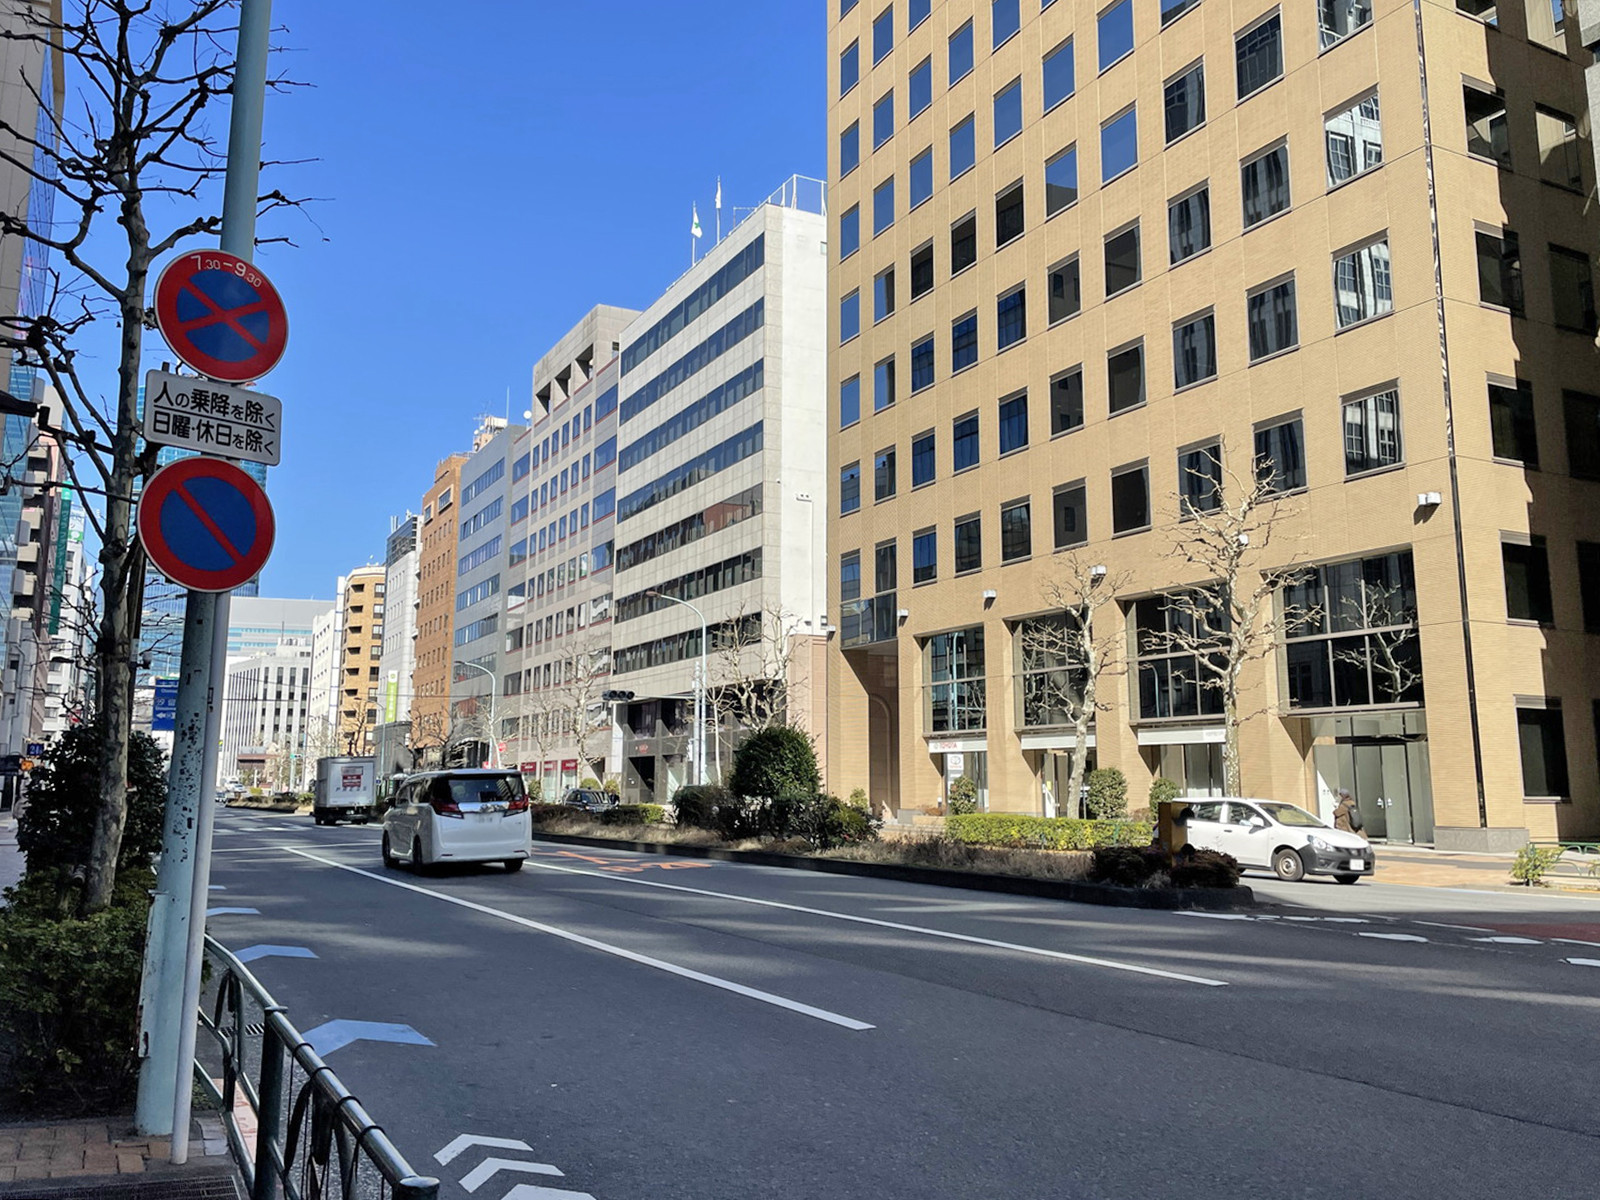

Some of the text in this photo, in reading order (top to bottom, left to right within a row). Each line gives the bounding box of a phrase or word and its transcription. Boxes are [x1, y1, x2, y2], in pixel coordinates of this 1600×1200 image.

[153, 381, 275, 428] 人の乗降を除く
